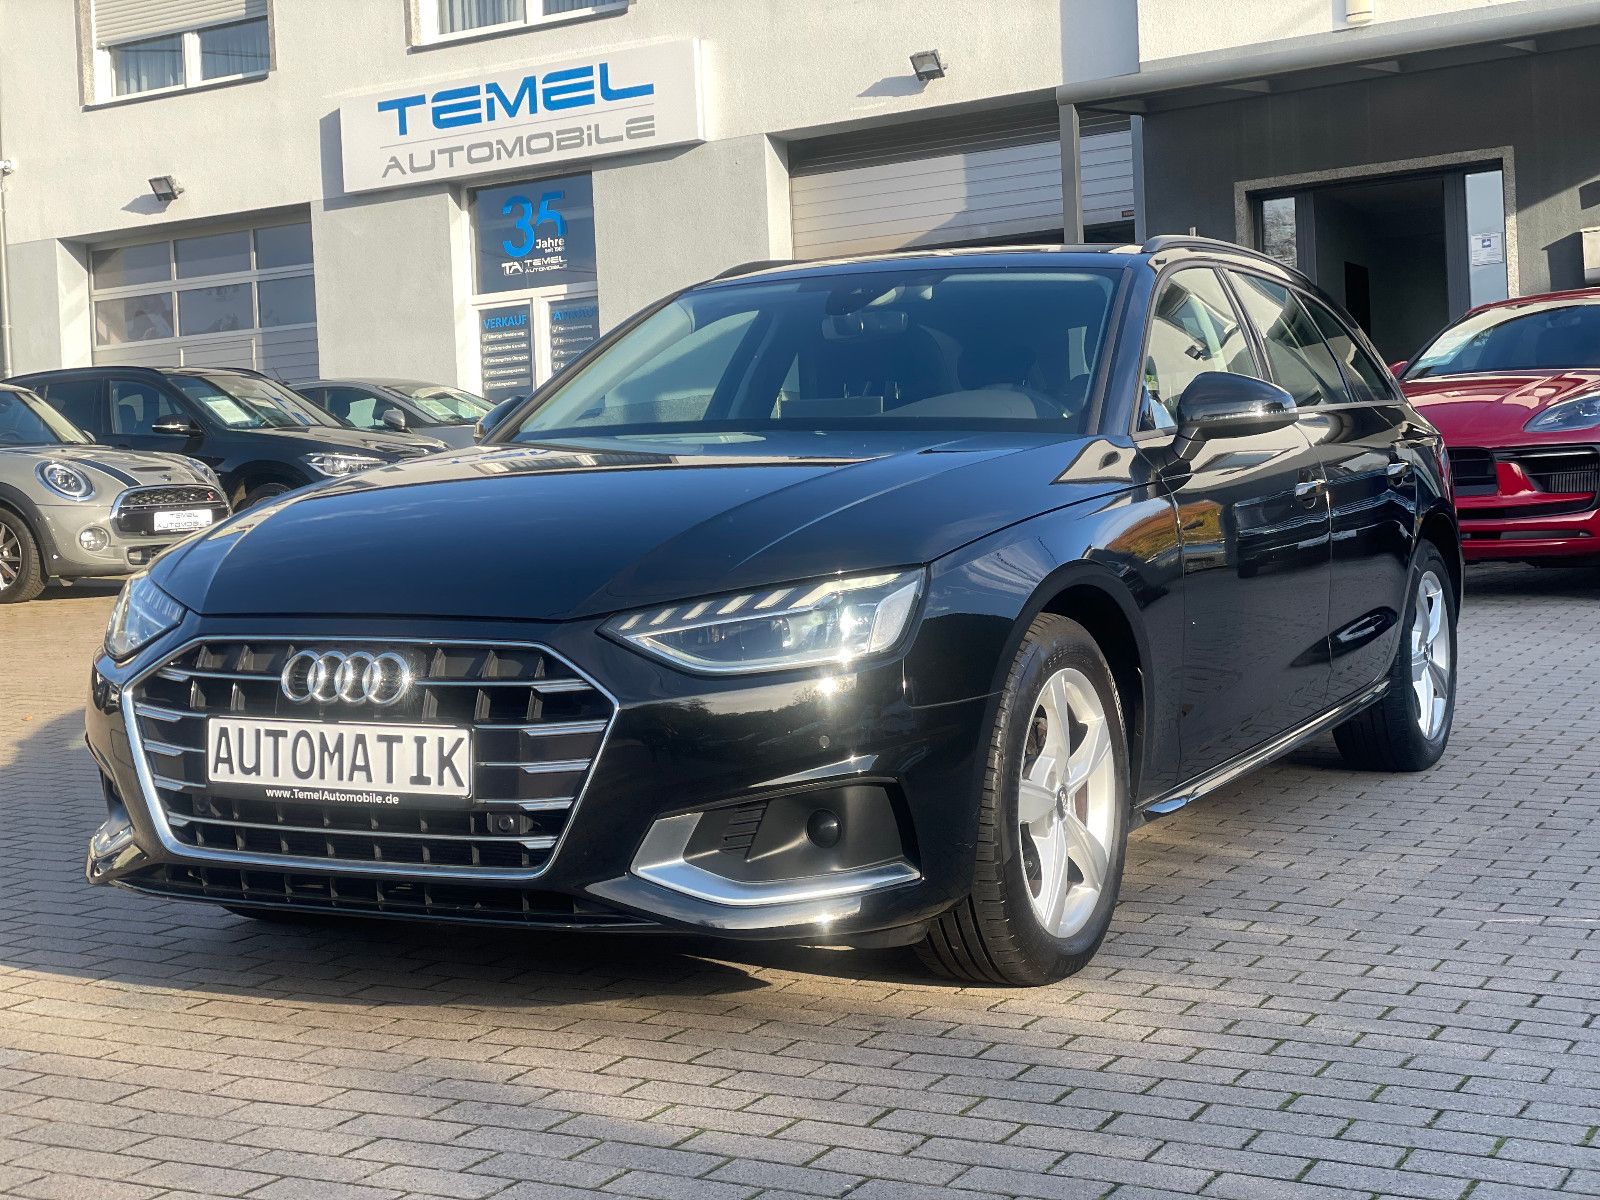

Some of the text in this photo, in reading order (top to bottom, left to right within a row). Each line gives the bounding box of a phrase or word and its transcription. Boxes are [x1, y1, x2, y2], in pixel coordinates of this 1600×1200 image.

[377, 62, 655, 136] TEMEL
[502, 190, 568, 257] 35
[536, 237, 565, 249] Jahre
[524, 256, 568, 267] TEMEL
[483, 314, 527, 329] VERKAUF
[213, 727, 465, 787] AUTOMATIK
[266, 788, 400, 805] www.TemelAutomobile.de
